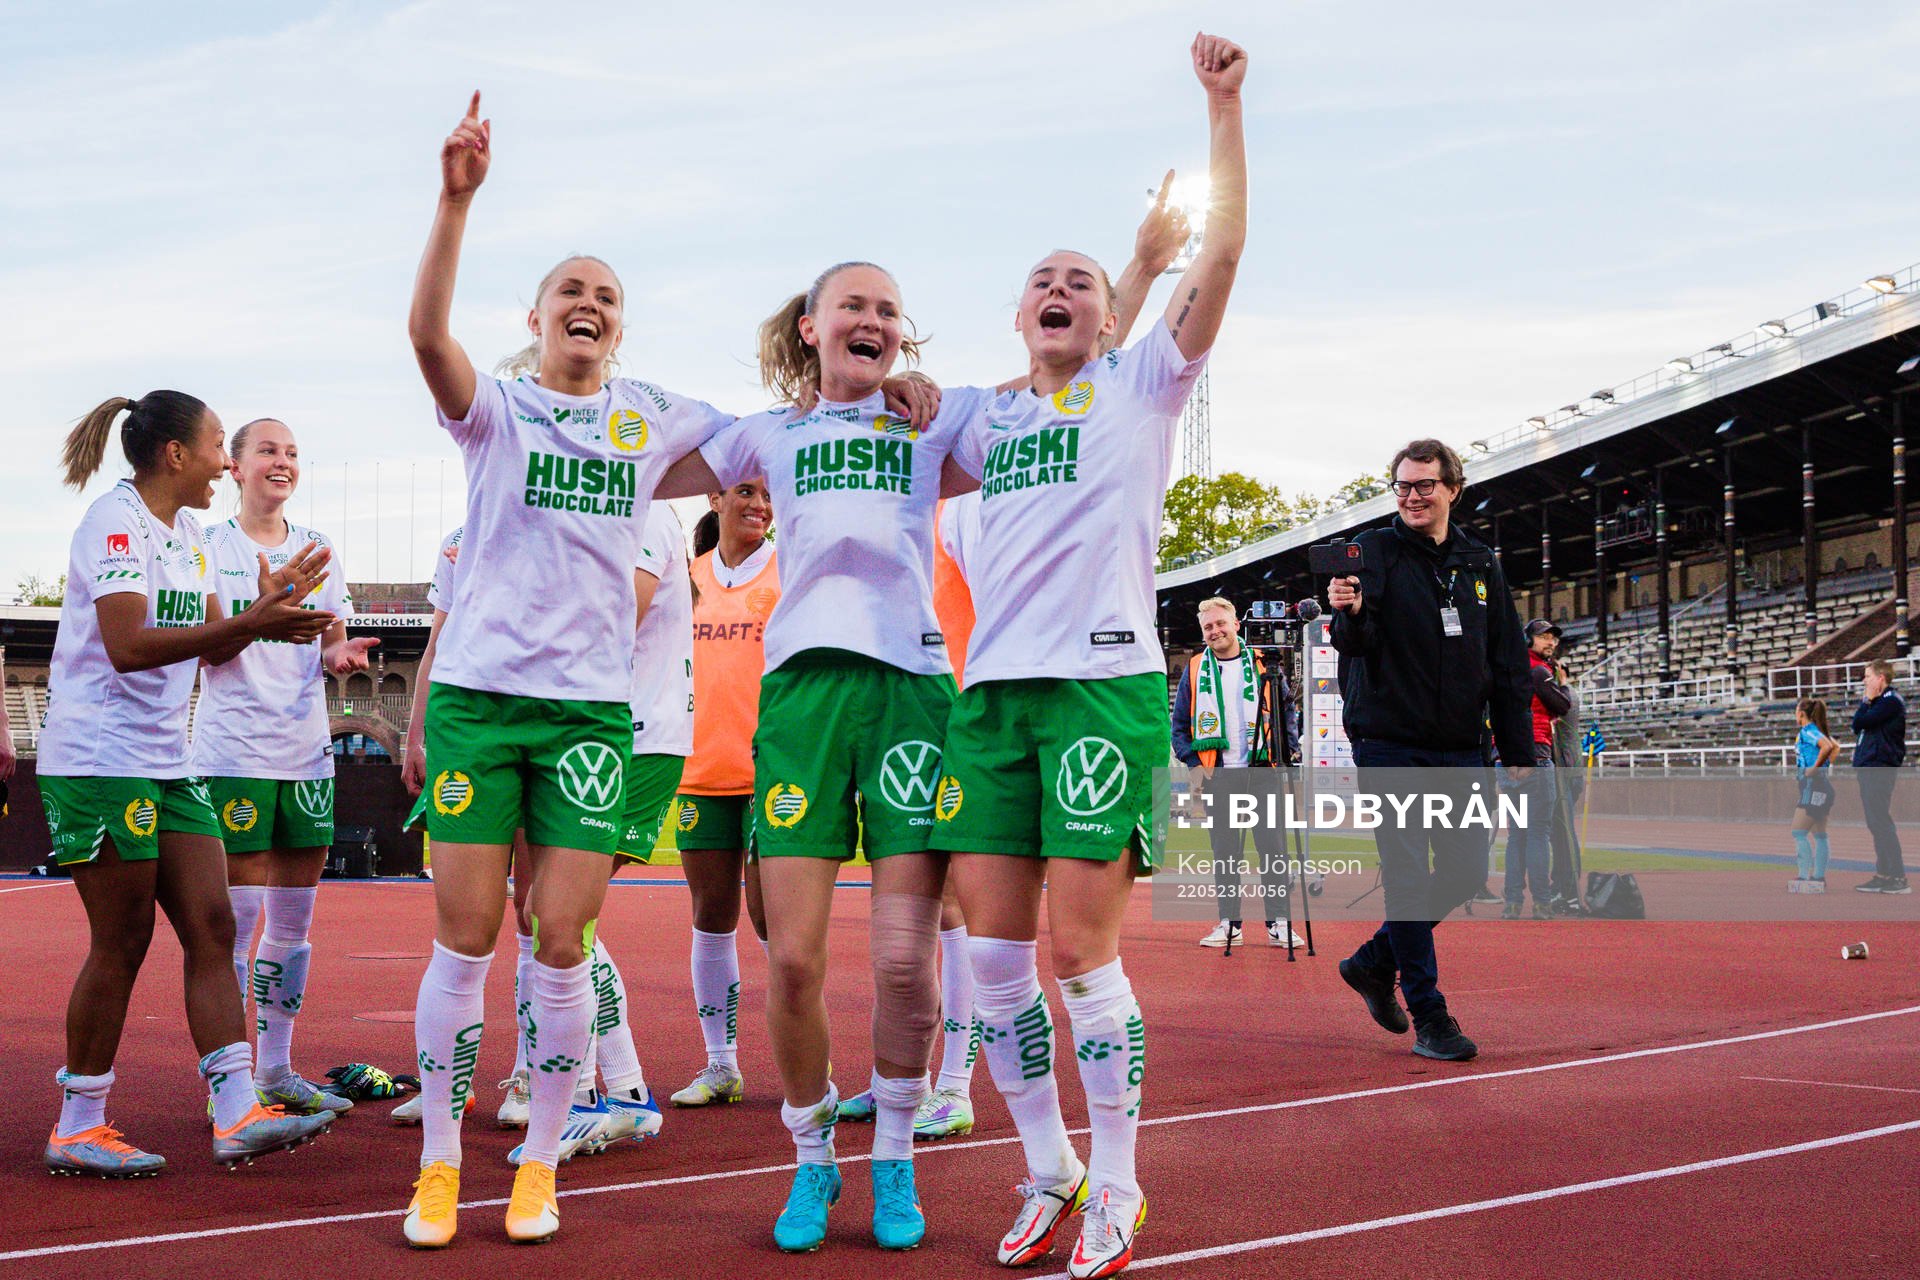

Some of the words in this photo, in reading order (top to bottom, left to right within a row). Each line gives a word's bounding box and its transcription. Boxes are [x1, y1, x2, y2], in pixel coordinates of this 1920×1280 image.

[631, 380, 672, 413] onvini
[572, 408, 599, 417] INTER
[572, 416, 599, 425] SPORT
[795, 438, 913, 480] HUSKI
[983, 427, 1080, 482] HUSKI
[526, 451, 636, 499] HUSKI
[795, 473, 912, 497] CHOCOLATE
[982, 463, 1078, 502] CHOCOLATE
[524, 488, 634, 518] CHOCOLATE
[156, 589, 204, 621] HUSK
[346, 618, 423, 626] TOCKHOLMS
[580, 816, 613, 831] CRAFT
[908, 817, 935, 826] CRA
[1065, 821, 1103, 833] CRAFT
